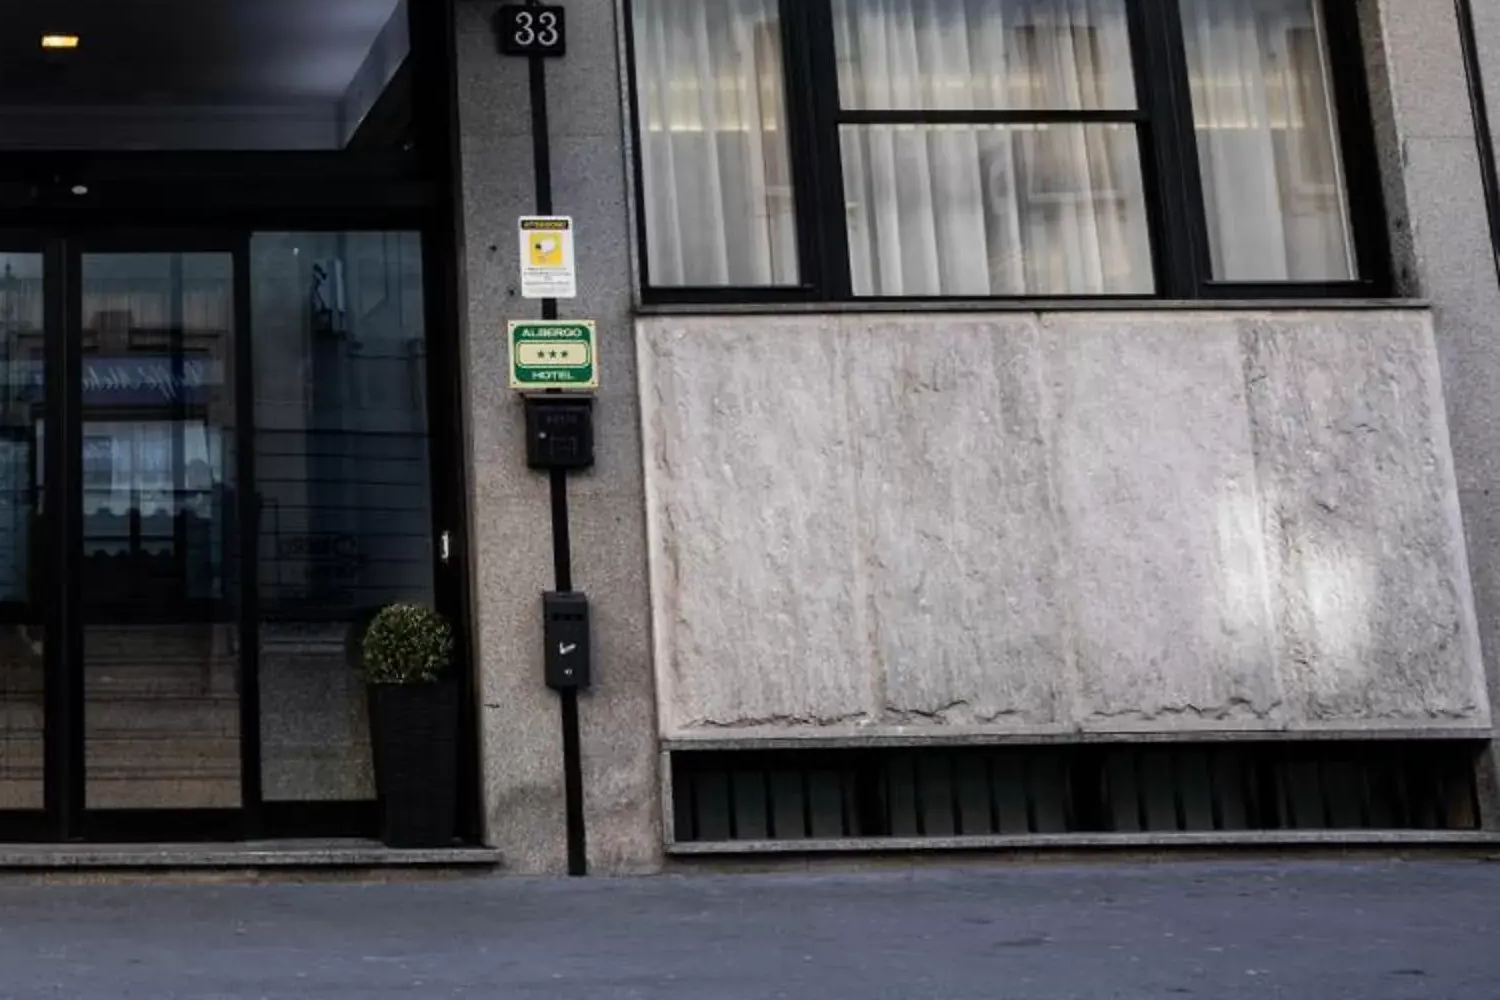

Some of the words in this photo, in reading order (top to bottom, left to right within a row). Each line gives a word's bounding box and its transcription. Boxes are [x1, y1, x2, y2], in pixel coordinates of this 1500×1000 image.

[515, 11, 559, 46] 33
[522, 327, 583, 339] ALBERGO
[531, 370, 575, 381] HOTEL
